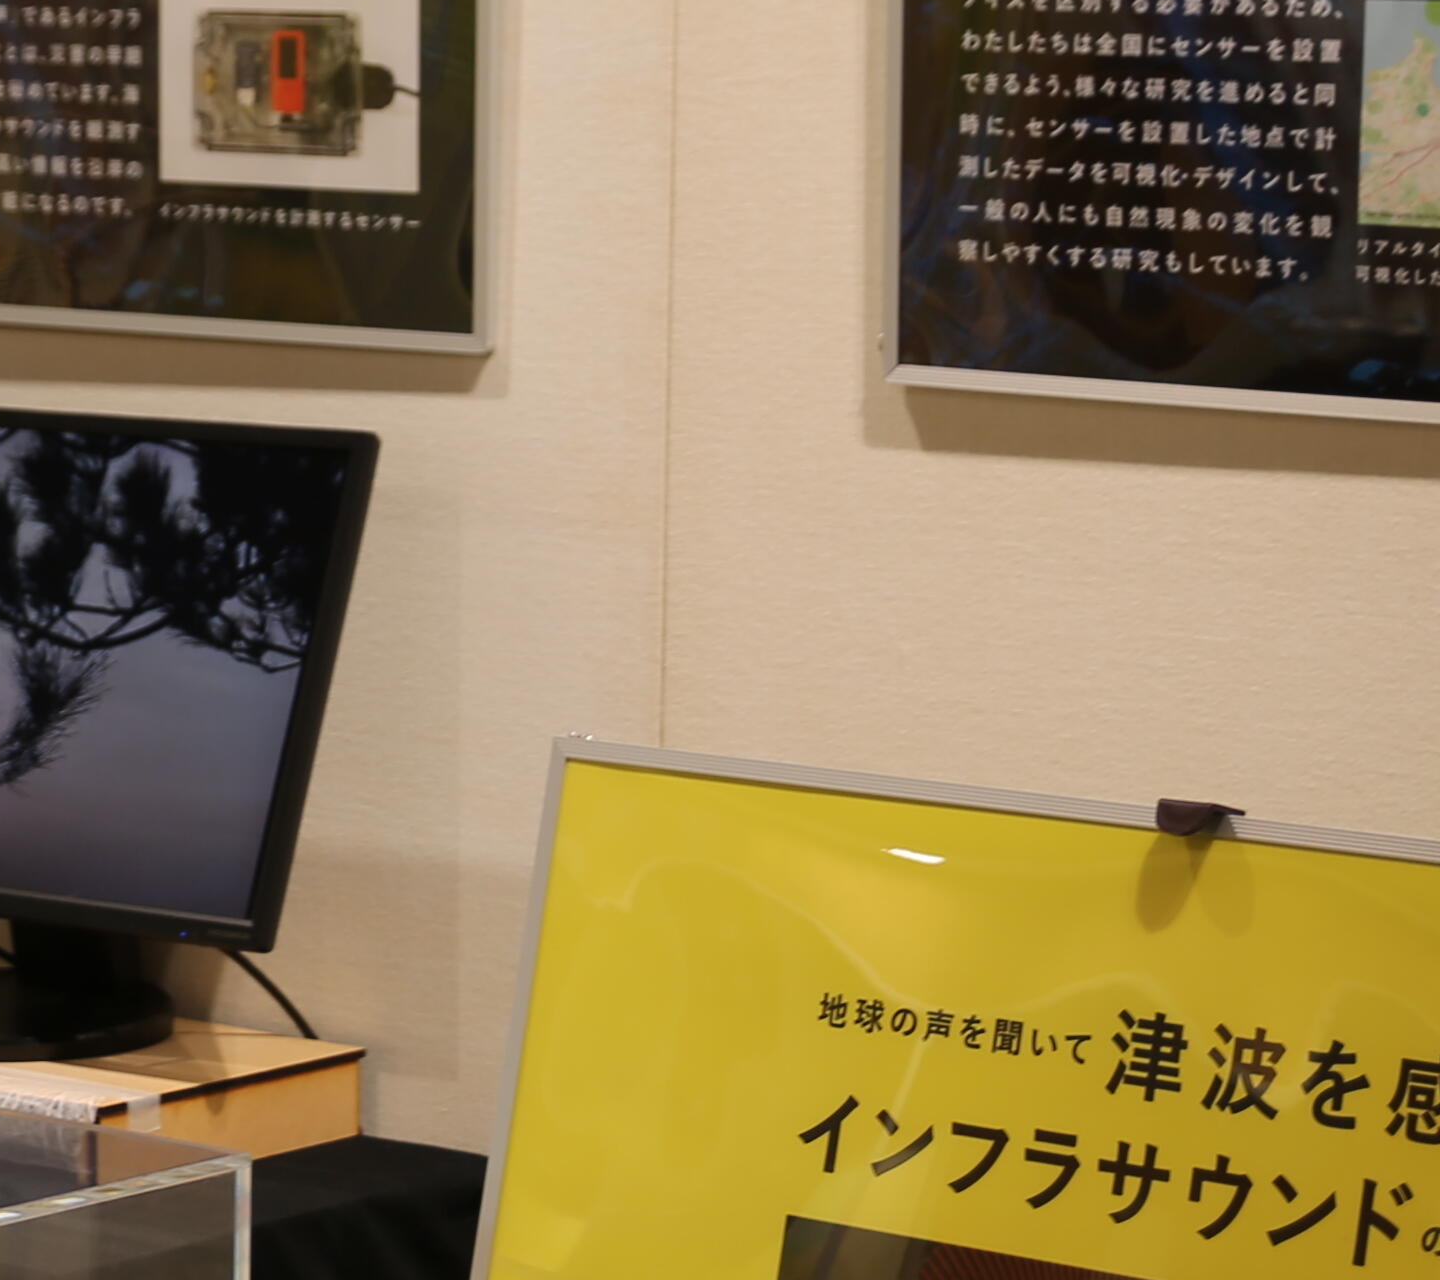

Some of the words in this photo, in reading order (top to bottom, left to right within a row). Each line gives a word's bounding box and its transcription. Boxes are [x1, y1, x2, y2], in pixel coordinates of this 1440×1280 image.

[961, 30, 1342, 63] わたしたちは全国にセンサーを設置
[961, 72, 1336, 107] できるよう、様々な研究を進めると同
[959, 114, 1336, 150] 時に、センサーを設置した地点で計
[958, 202, 1333, 238] 一般の人にも自然現象の変化を観
[958, 239, 1310, 282] 察しやすくする研究もしています。
[818, 992, 1092, 1065] 地球の声を聞いて
[798, 1095, 1414, 1268] インフラサウンド
